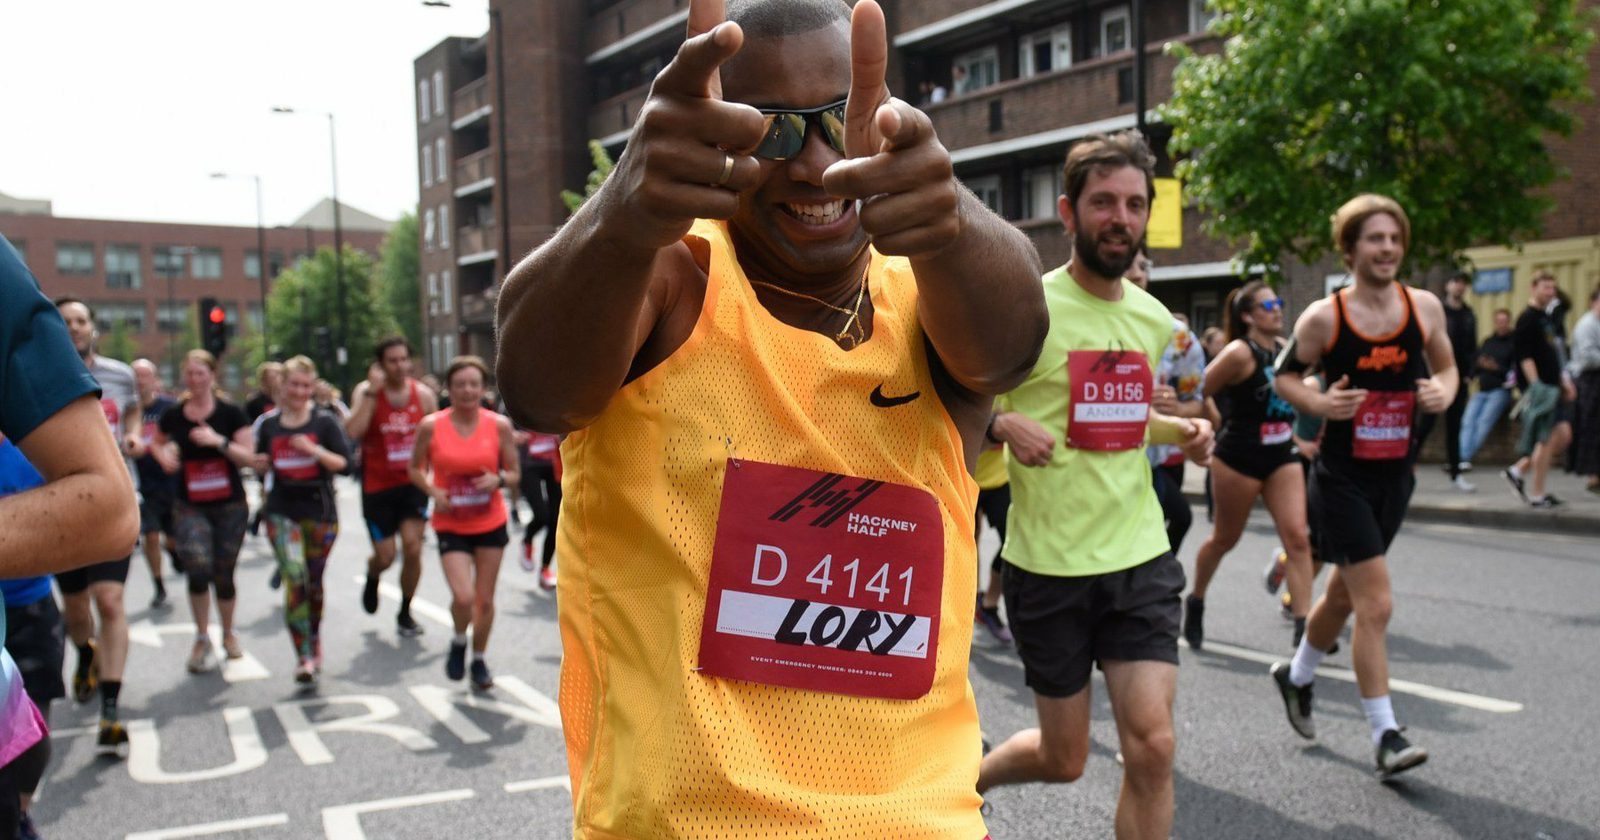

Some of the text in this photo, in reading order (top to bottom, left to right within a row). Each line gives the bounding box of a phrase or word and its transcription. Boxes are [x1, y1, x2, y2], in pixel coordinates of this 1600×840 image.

[1083, 381, 1144, 402] D 9156
[847, 524, 888, 537] HALF
[848, 512, 917, 532] HACKNEY
[751, 544, 913, 606] D 4141
[775, 599, 916, 656] LORY
[750, 655, 773, 664] EVENT
[775, 659, 816, 669] EMERGENCY
